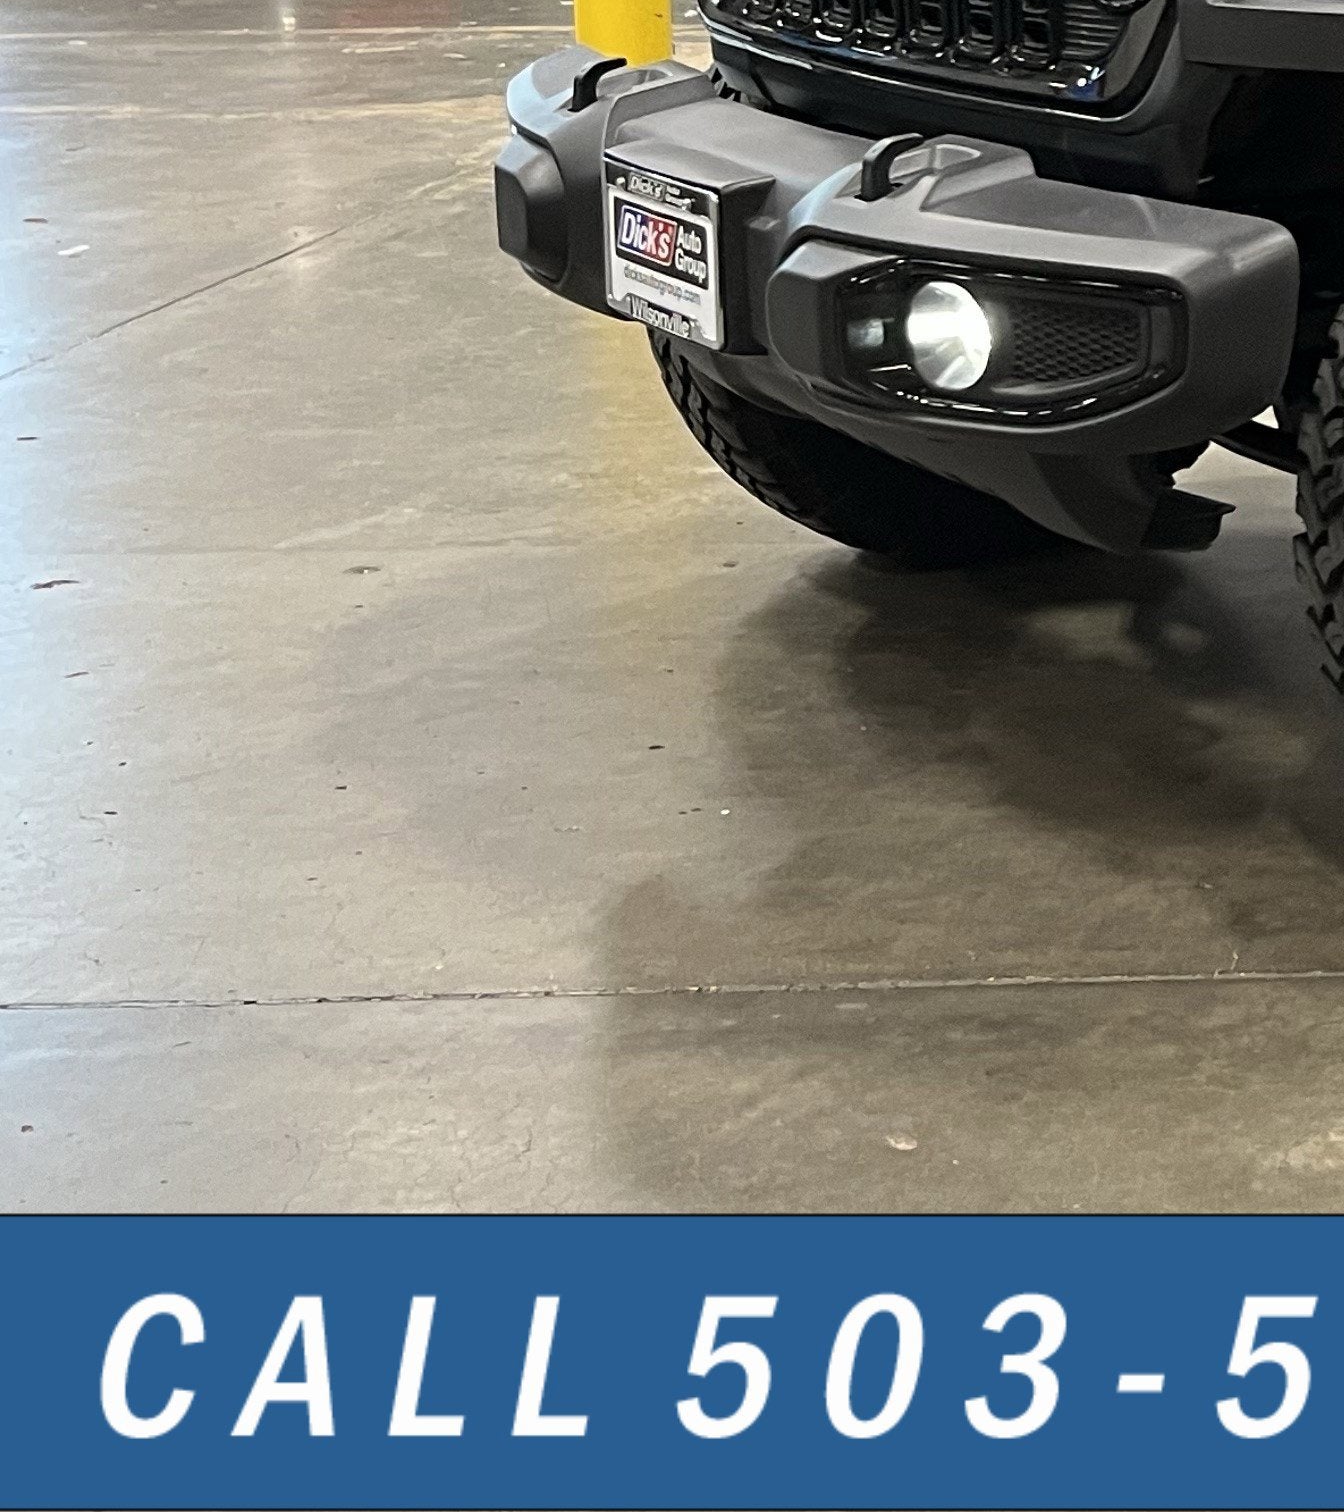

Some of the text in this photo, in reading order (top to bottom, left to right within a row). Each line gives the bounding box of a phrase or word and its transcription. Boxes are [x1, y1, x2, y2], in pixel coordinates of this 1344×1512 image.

[620, 209, 672, 260] Dick's
[675, 225, 703, 255] Auto
[674, 247, 708, 284] Group
